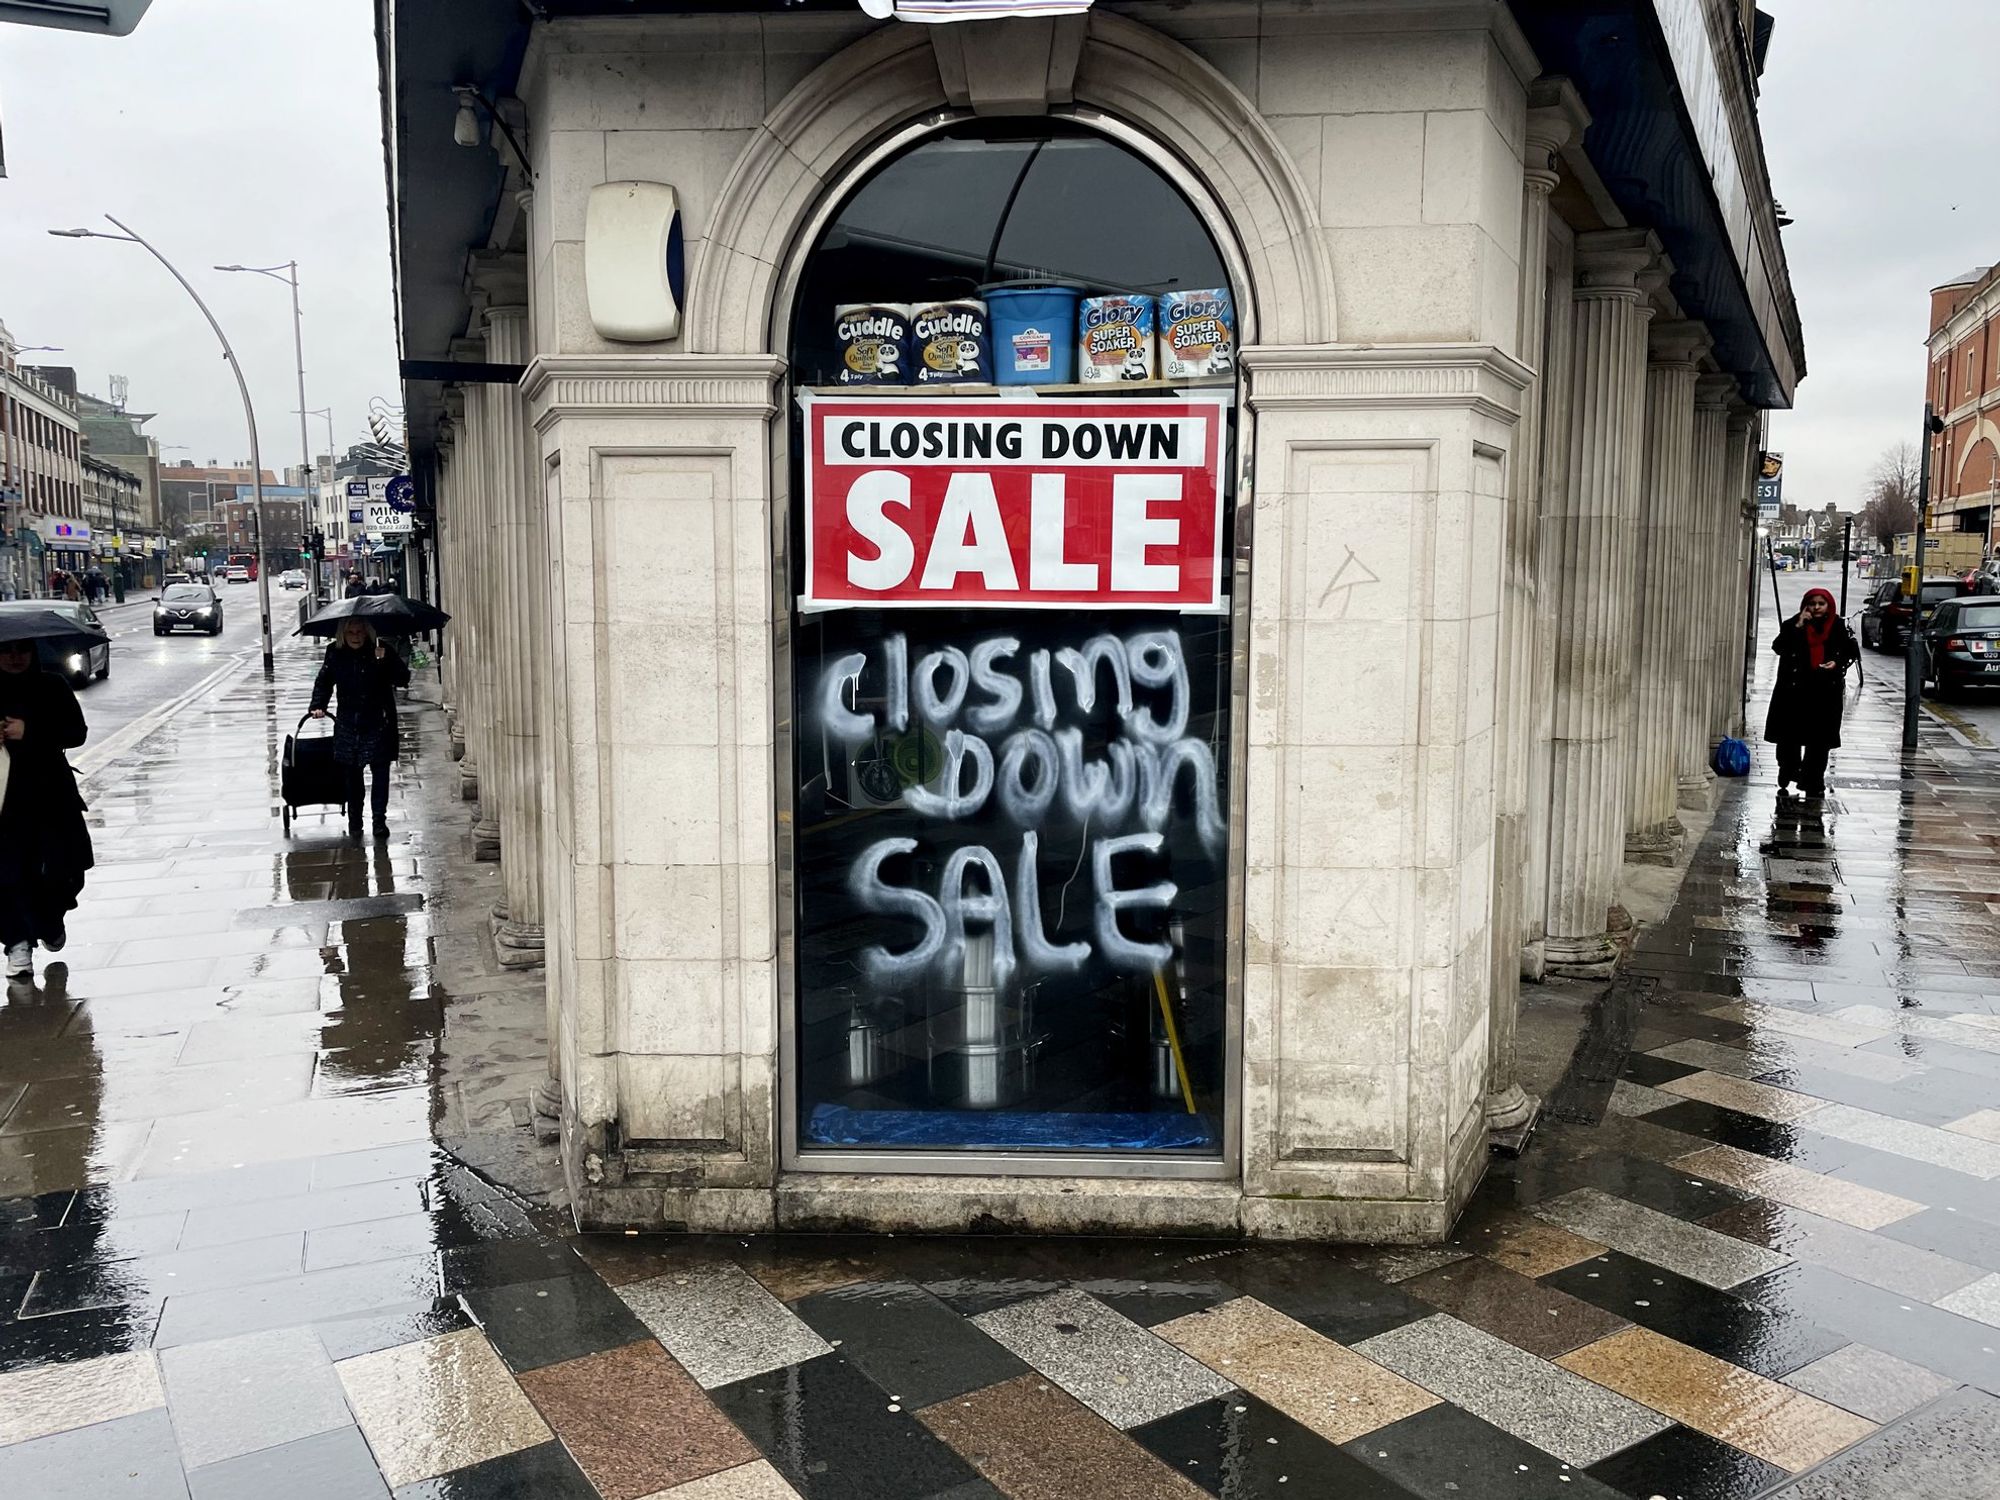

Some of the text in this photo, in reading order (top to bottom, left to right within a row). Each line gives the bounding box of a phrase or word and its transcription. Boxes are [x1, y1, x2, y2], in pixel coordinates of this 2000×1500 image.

[1086, 305, 1144, 328] Glory
[1169, 300, 1229, 323] Glory
[838, 317, 903, 340] Cuddle
[915, 313, 982, 339] Cuddle
[1092, 326, 1130, 342] SUPER
[1176, 321, 1216, 337] SUPER
[1090, 338, 1136, 355] SOAKER
[1173, 331, 1221, 350] SOAKER
[856, 346, 873, 356] Soft
[936, 344, 953, 354] Soft
[840, 369, 849, 383] 4
[918, 367, 928, 381] 4
[1084, 367, 1094, 379] 4
[1168, 362, 1178, 375] 4
[841, 421, 1179, 460] CLOSING DOWN
[376, 516, 400, 525] CAB
[845, 469, 1183, 592] SALE
[1984, 663, 2000, 672] Au
[850, 830, 1178, 980] SALE
